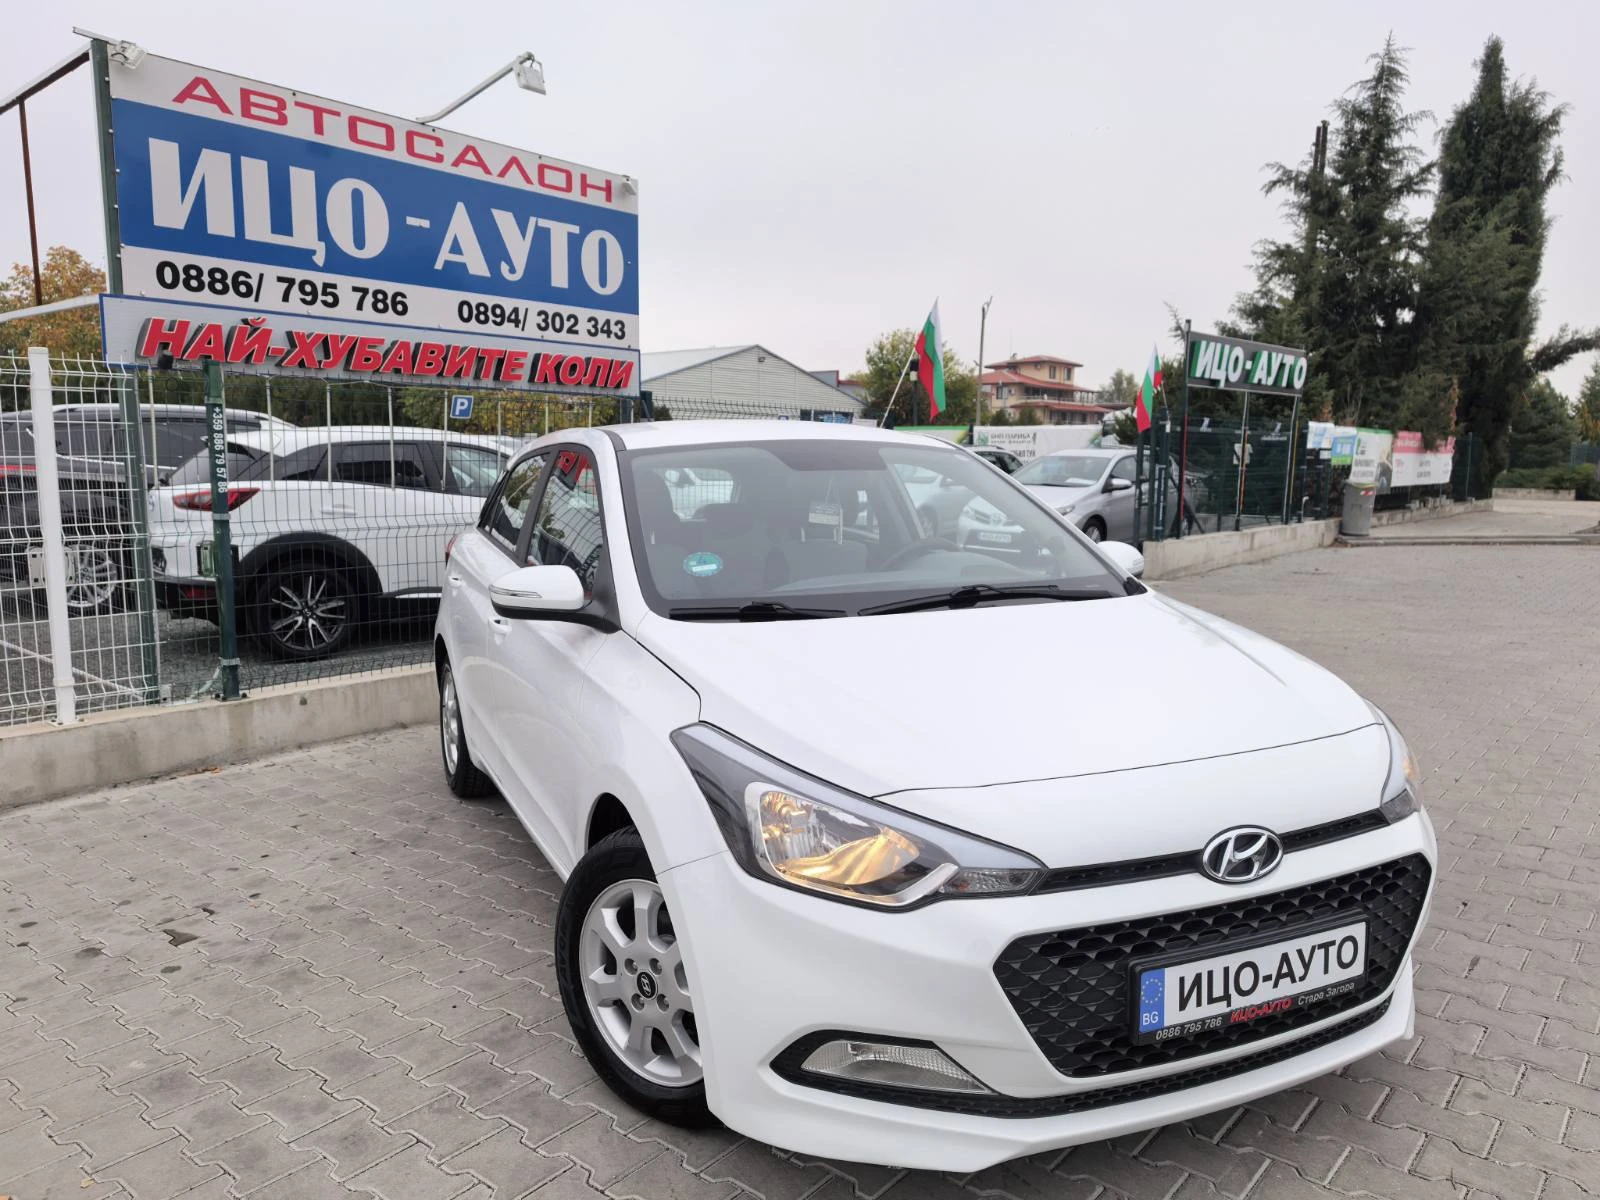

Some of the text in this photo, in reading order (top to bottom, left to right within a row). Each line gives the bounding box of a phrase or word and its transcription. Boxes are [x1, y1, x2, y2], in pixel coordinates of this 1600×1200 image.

[172, 76, 613, 203] АВТОСАЛОН
[276, 275, 339, 308] 795
[352, 286, 408, 316] 786
[536, 310, 579, 335] 302
[586, 316, 626, 340] 343
[139, 316, 635, 389] НАЙ-ХУБАВИТЕ КОЛИ
[1193, 340, 1307, 389] ИЦО-АУТО
[455, 399, 469, 415] P
[213, 406, 227, 493] +359 886 79 57 86
[1178, 935, 1359, 1012] ИЦО-АУТО
[1142, 1011, 1158, 1025] BG
[1155, 1026, 1181, 1040] 0886
[1184, 1022, 1201, 1034] 795
[1204, 1017, 1222, 1029] 786
[1231, 998, 1294, 1023] ИЦО-АУТО
[1326, 982, 1355, 997] Загора
